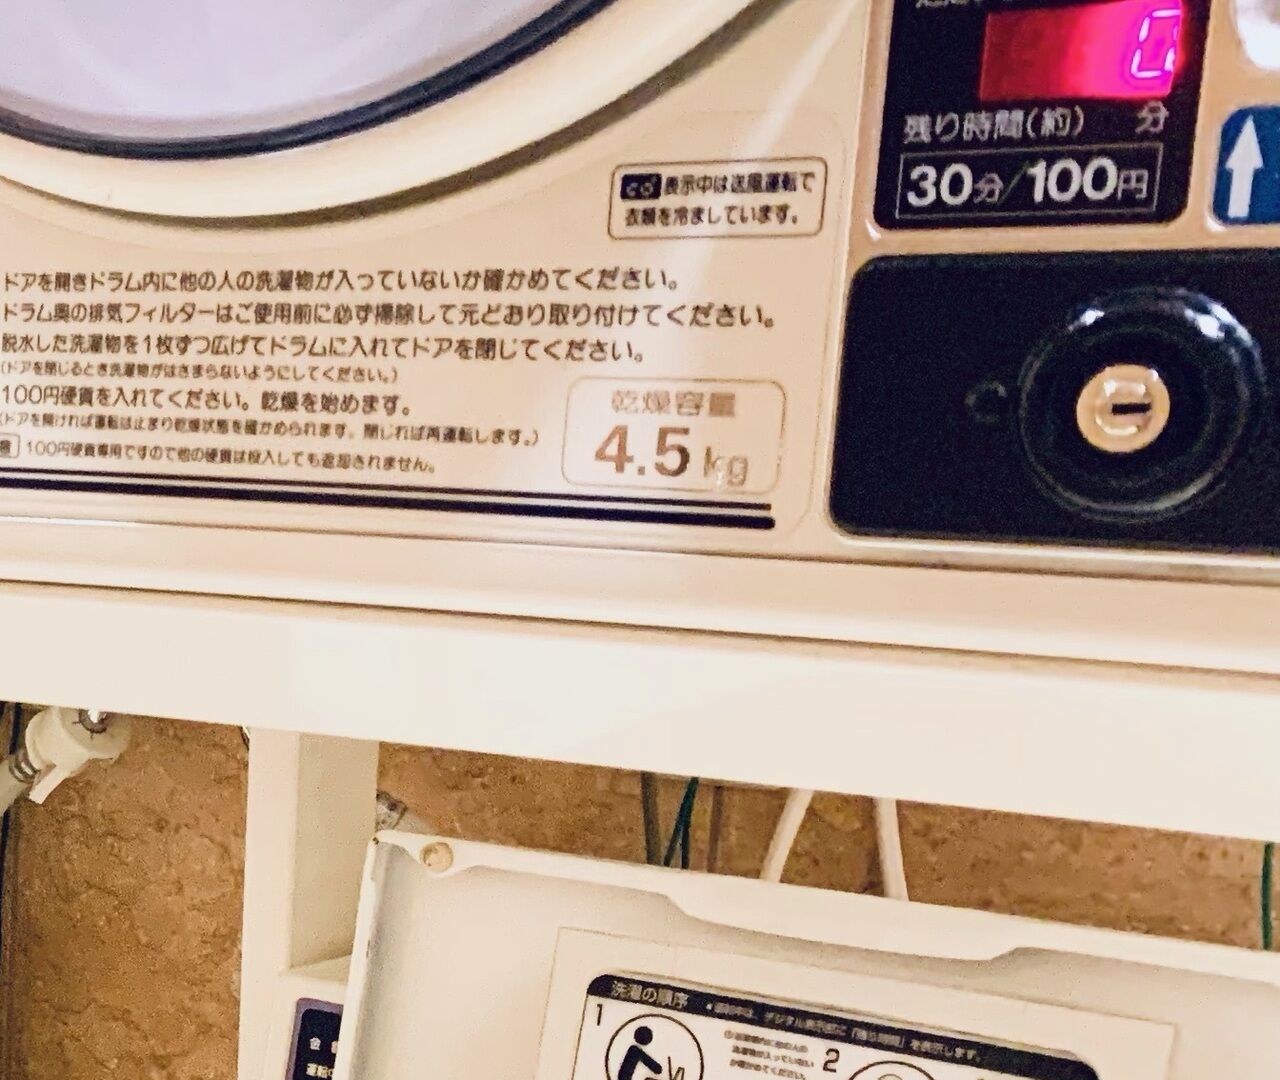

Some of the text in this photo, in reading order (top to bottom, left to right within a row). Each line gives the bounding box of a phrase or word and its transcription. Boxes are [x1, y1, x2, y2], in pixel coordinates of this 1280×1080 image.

[1136, 101, 1169, 134] 分
[594, 424, 749, 487] 4.5 kg
[596, 1003, 603, 1026] 1
[822, 1048, 840, 1073] 2
